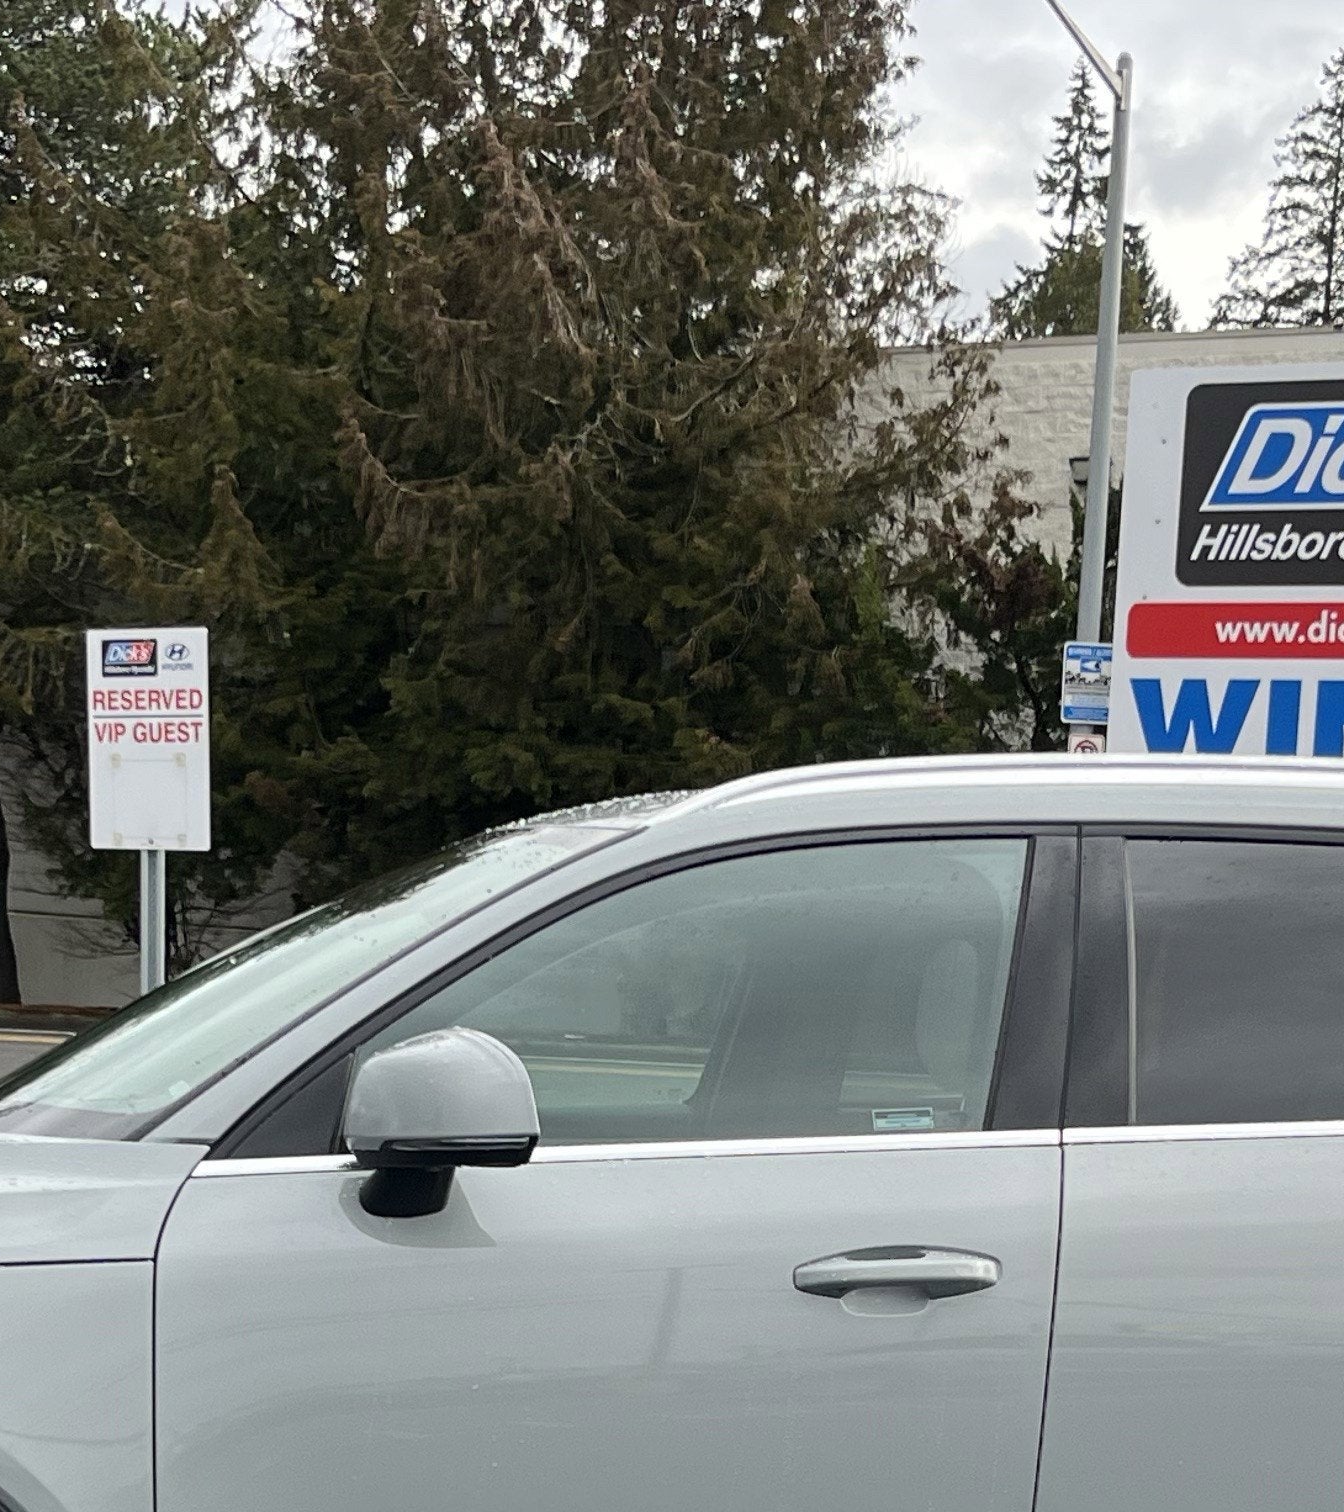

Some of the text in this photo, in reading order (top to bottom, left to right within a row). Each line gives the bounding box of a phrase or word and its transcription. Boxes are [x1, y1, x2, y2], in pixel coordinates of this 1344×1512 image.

[93, 689, 203, 710] RESERVED
[94, 722, 202, 743] VIP GUEST
